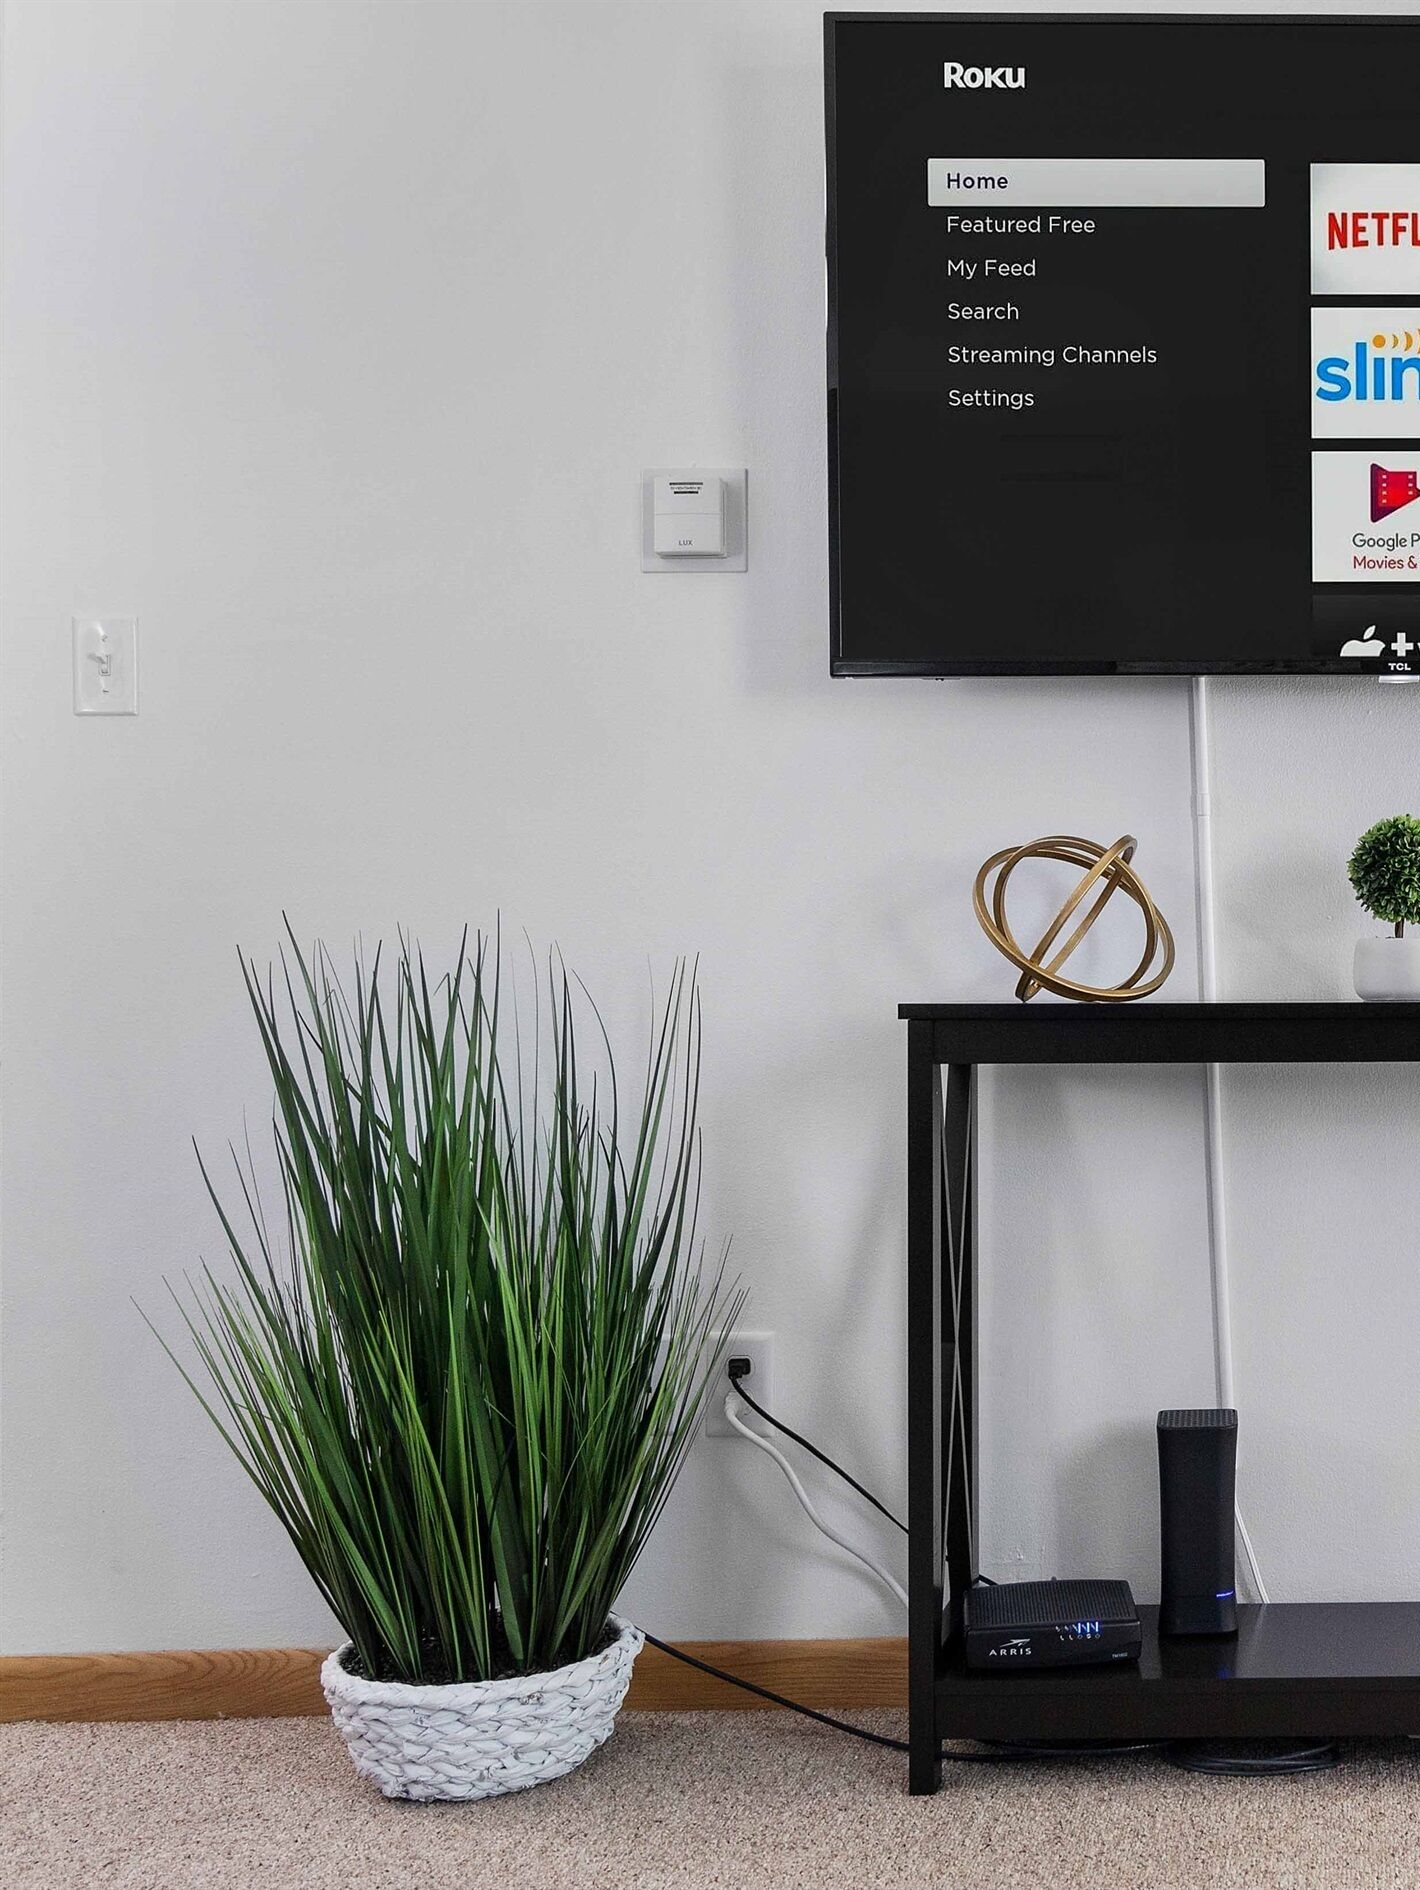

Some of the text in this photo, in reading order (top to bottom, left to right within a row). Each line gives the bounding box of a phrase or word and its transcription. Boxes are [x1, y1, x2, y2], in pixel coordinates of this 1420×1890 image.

[944, 62, 1025, 89] Roku
[946, 172, 1009, 190] Home
[947, 215, 1096, 233] Featured Free
[948, 259, 1036, 280] My Feed
[948, 302, 1019, 320] Search
[948, 346, 1157, 366] Streaming Channels
[948, 389, 1035, 410] Settings
[1352, 532, 1408, 552] Google
[1352, 555, 1404, 570] Movies
[1407, 556, 1418, 570] &
[1388, 663, 1411, 671] TCL
[989, 1647, 1032, 1656] ARRIS
